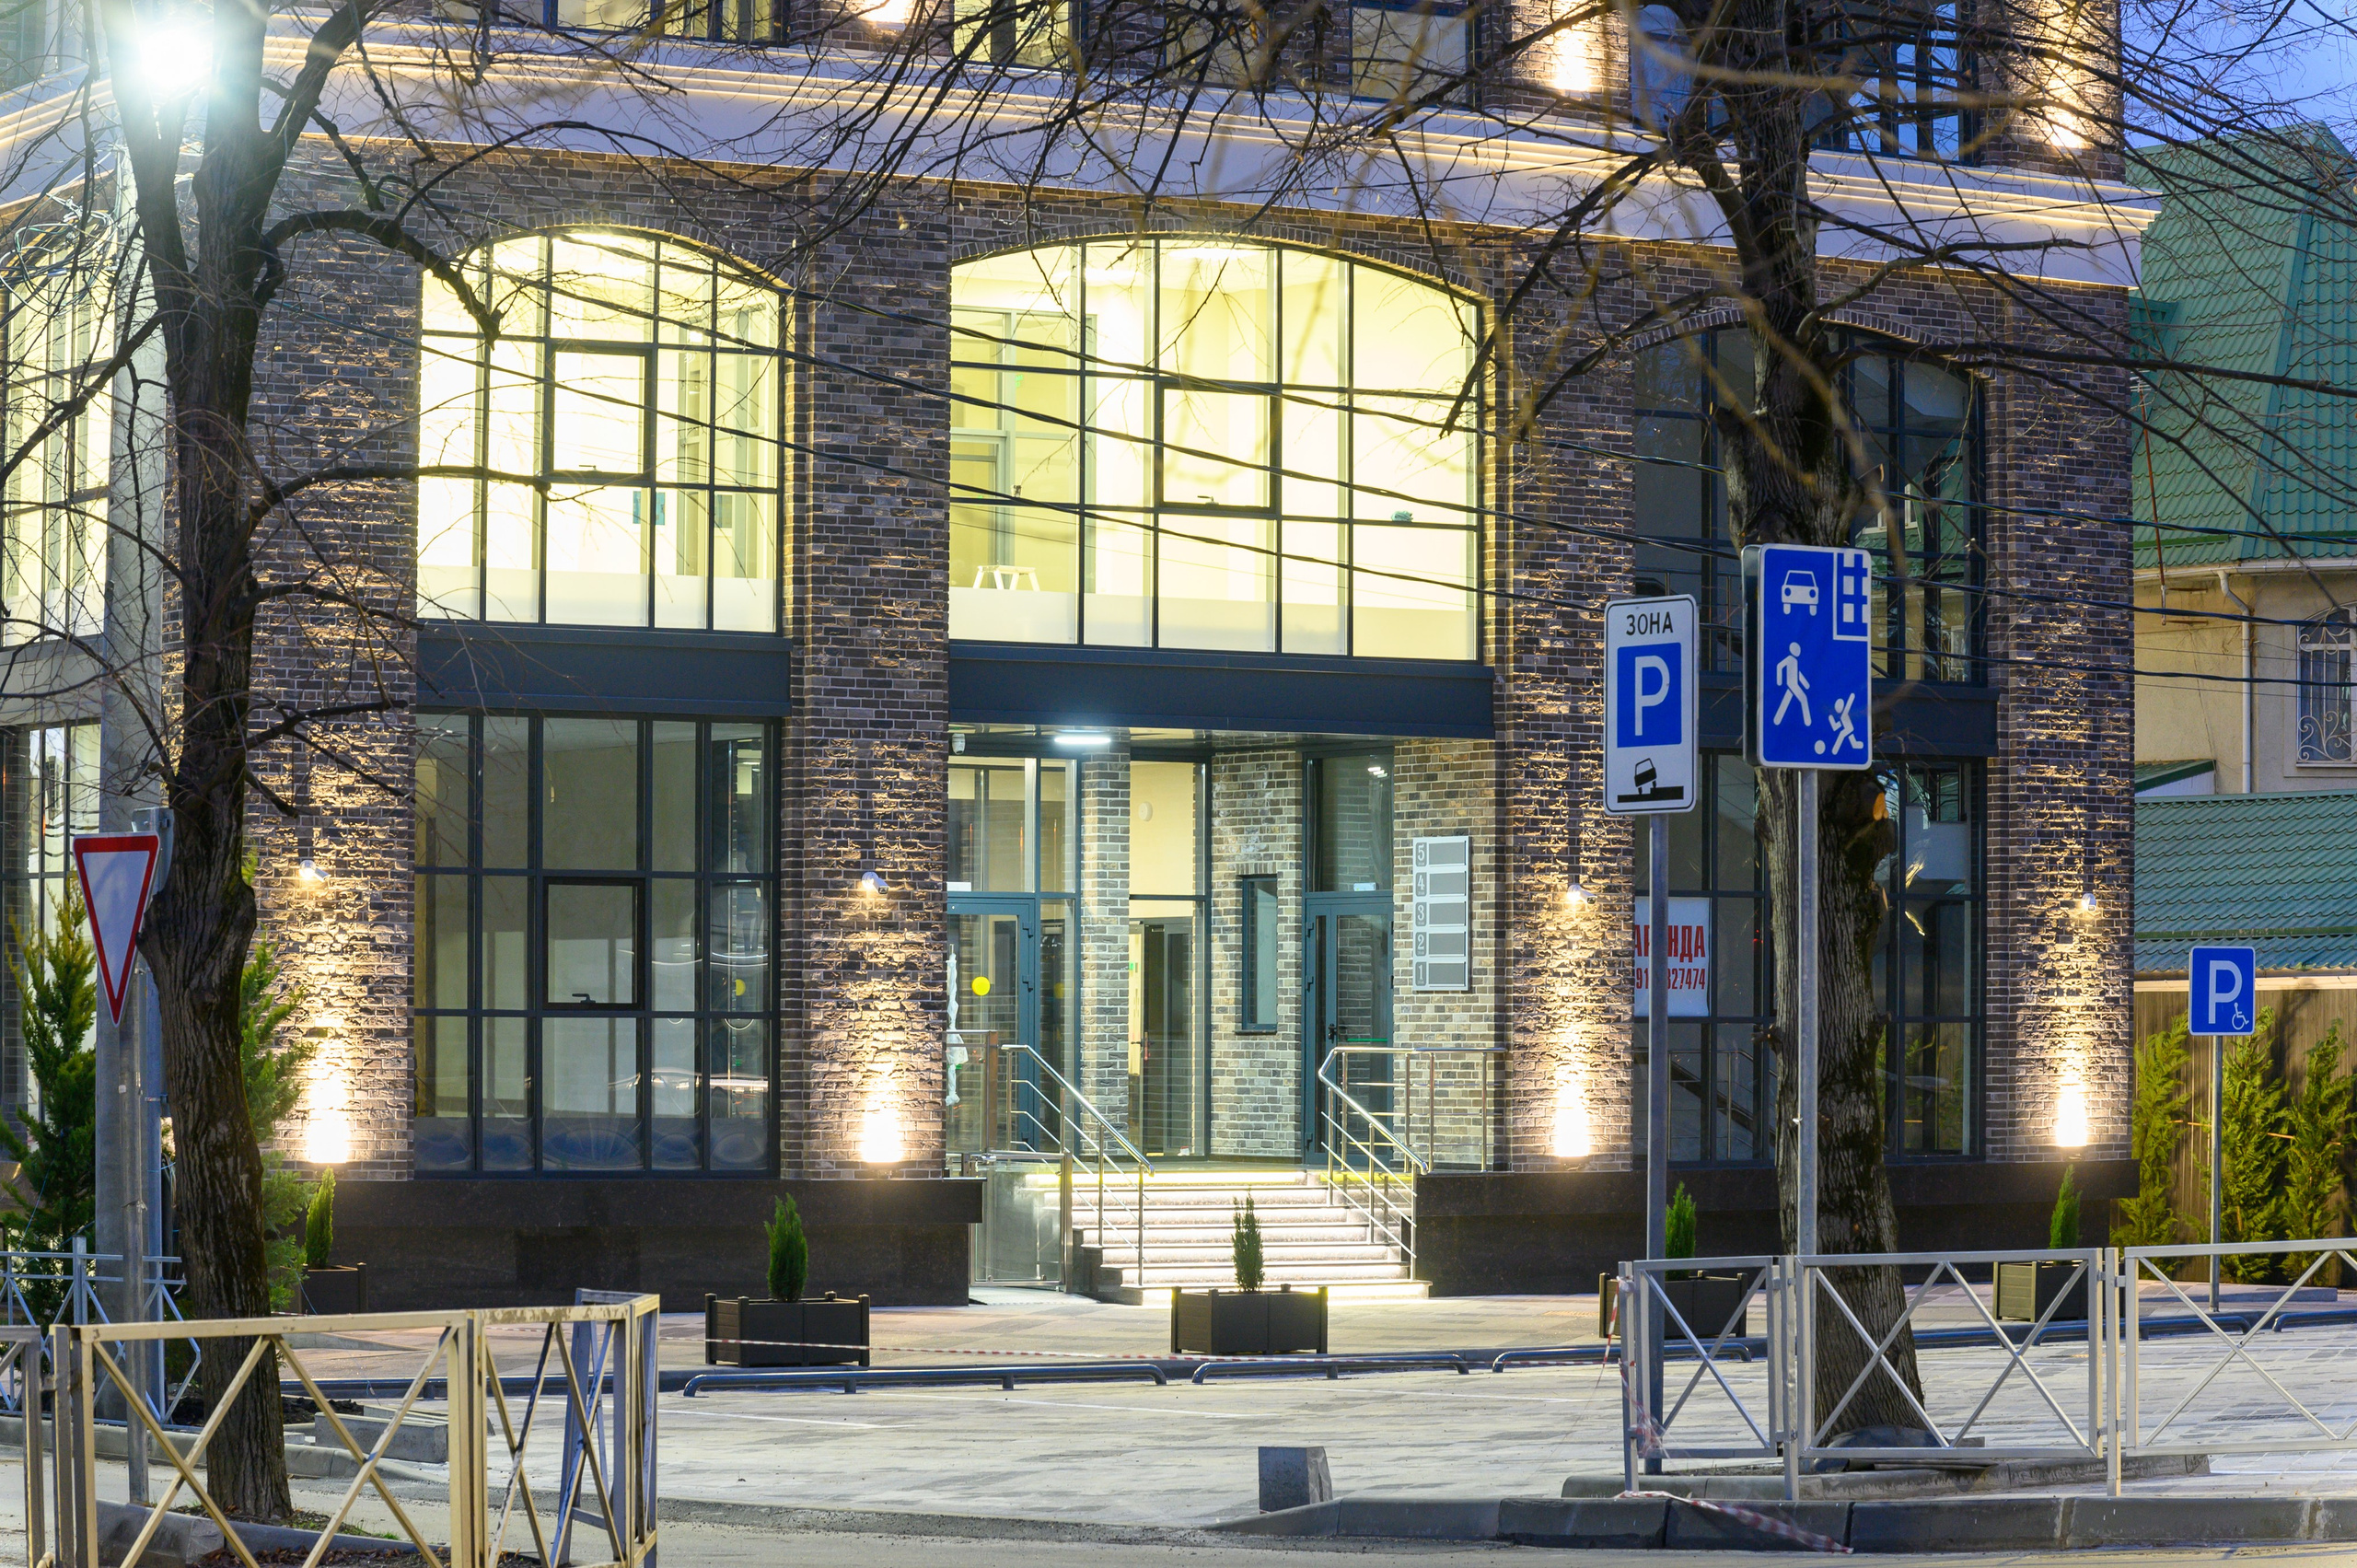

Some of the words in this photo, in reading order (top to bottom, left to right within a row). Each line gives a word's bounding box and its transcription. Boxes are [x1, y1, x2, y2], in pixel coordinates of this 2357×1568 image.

[1626, 611, 1673, 635] ЗОНА
[1634, 655, 1670, 737] P
[1418, 843, 1425, 861] 5
[1418, 875, 1425, 890] 4
[1417, 904, 1424, 921] 3
[1418, 934, 1424, 950] 2
[1634, 924, 1706, 963] АРНДА
[1418, 964, 1424, 981] 1
[1636, 968, 1706, 990] 9127474
[2208, 959, 2243, 1024] P
